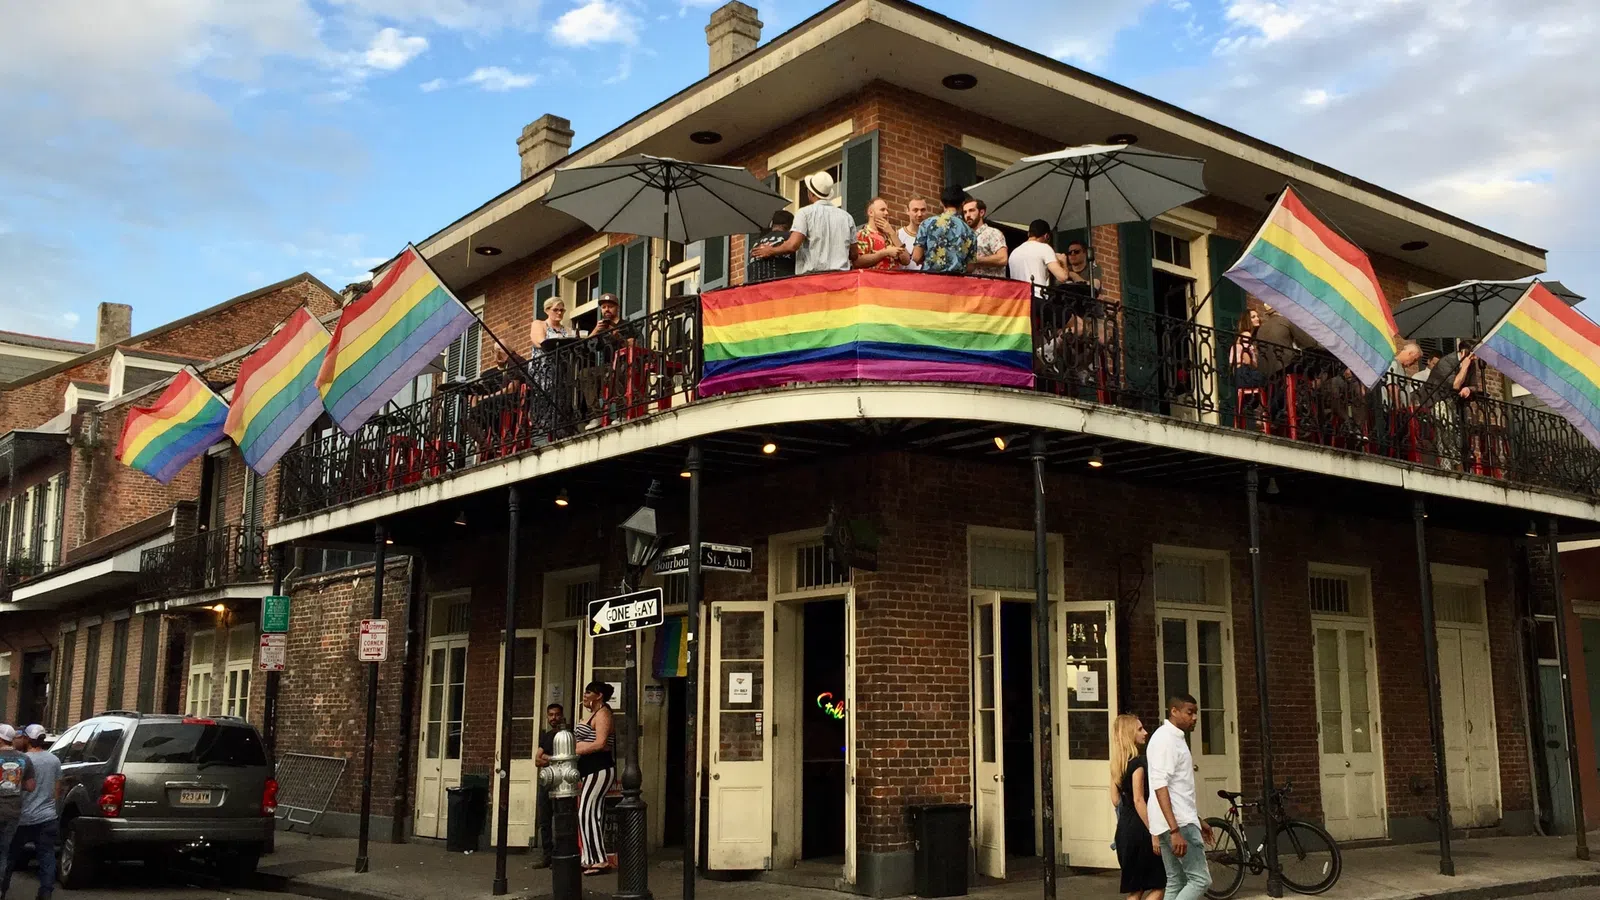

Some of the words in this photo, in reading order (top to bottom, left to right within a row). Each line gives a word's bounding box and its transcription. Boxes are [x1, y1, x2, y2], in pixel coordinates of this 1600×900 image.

[654, 557, 689, 571] Bourbon
[706, 552, 720, 565] St.
[725, 555, 746, 568] Ann
[606, 606, 630, 622] GONE
[361, 623, 369, 631] NO
